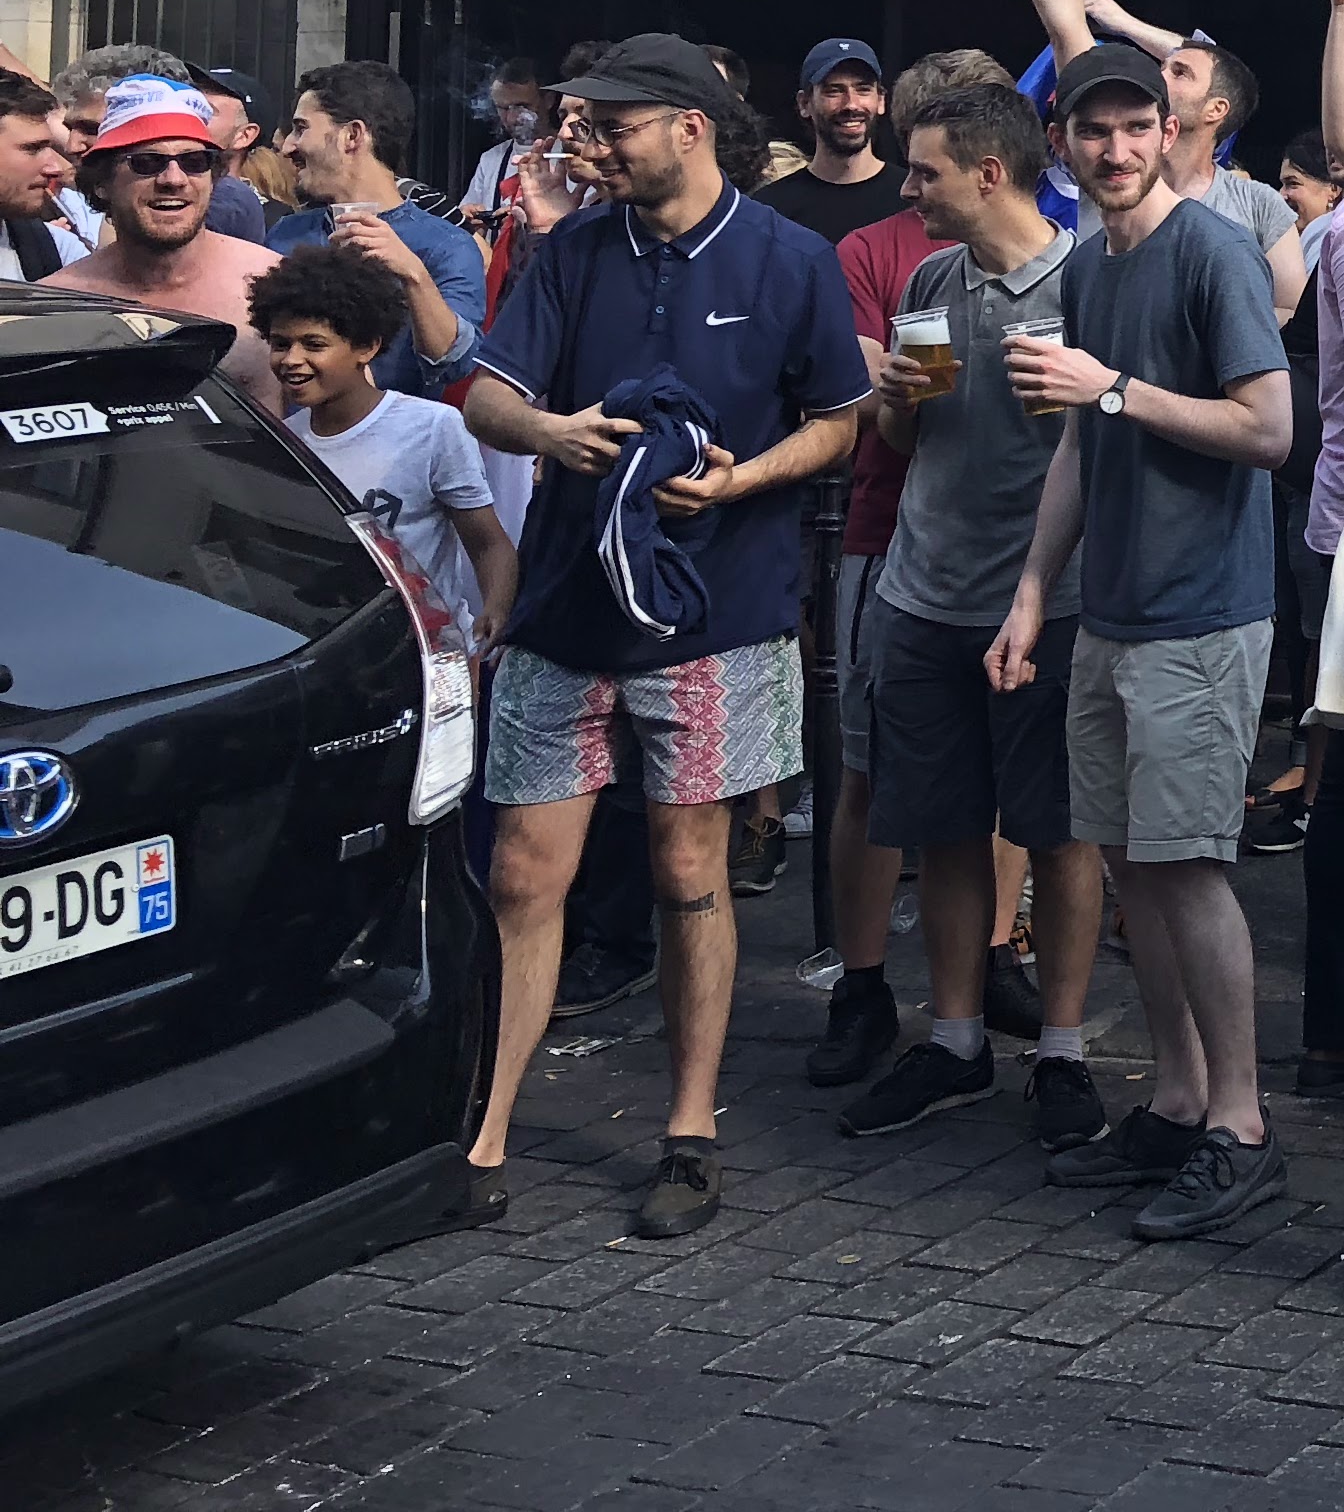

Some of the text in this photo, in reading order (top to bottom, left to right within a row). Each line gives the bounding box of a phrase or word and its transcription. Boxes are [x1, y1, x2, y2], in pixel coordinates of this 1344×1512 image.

[9, 408, 89, 436] 3607
[107, 405, 147, 416] Service
[142, 891, 169, 924] 75
